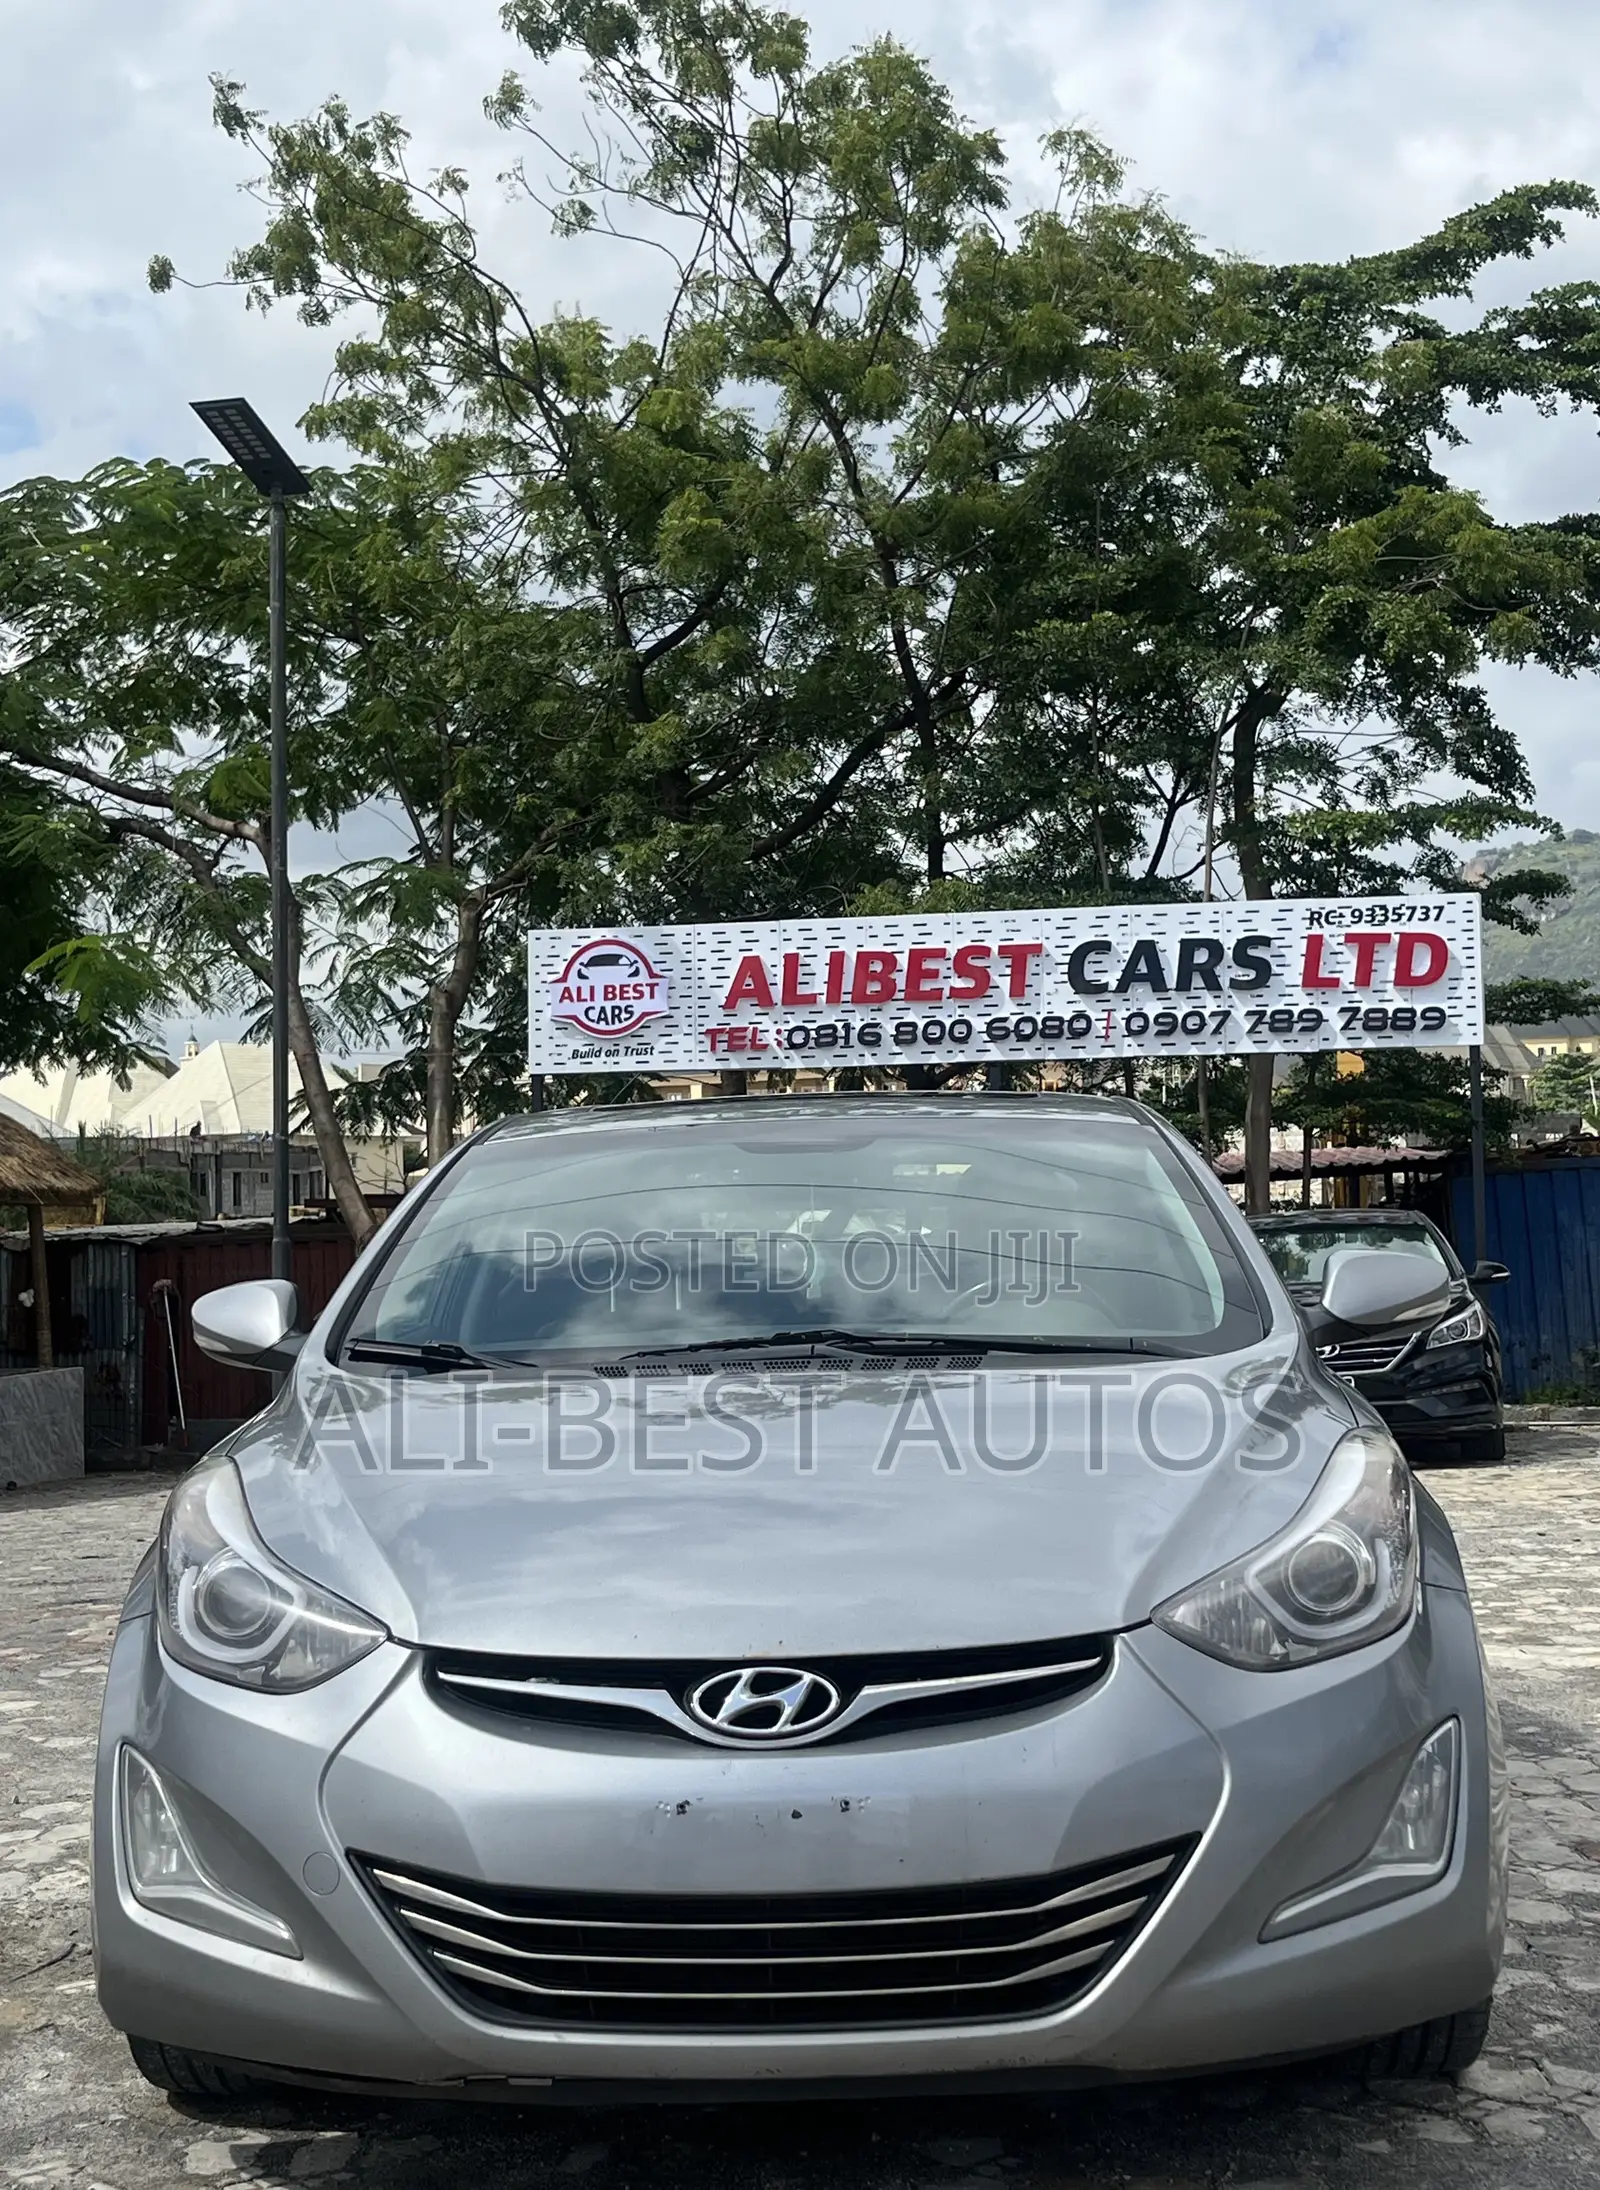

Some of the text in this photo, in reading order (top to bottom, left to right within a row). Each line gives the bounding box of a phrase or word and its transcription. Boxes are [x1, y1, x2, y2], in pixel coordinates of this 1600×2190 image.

[722, 931, 1449, 1010] ALIBEST CARS LTD
[558, 982, 659, 1004] ALI BEST
[584, 1004, 635, 1026] CARS
[892, 1018, 973, 1046] 800
[986, 1013, 1093, 1043] 6080
[1125, 1009, 1232, 1037] 0907
[1244, 1007, 1324, 1034] 789
[1338, 1005, 1448, 1032] 7889
[571, 1045, 655, 1060] Build on Trust
